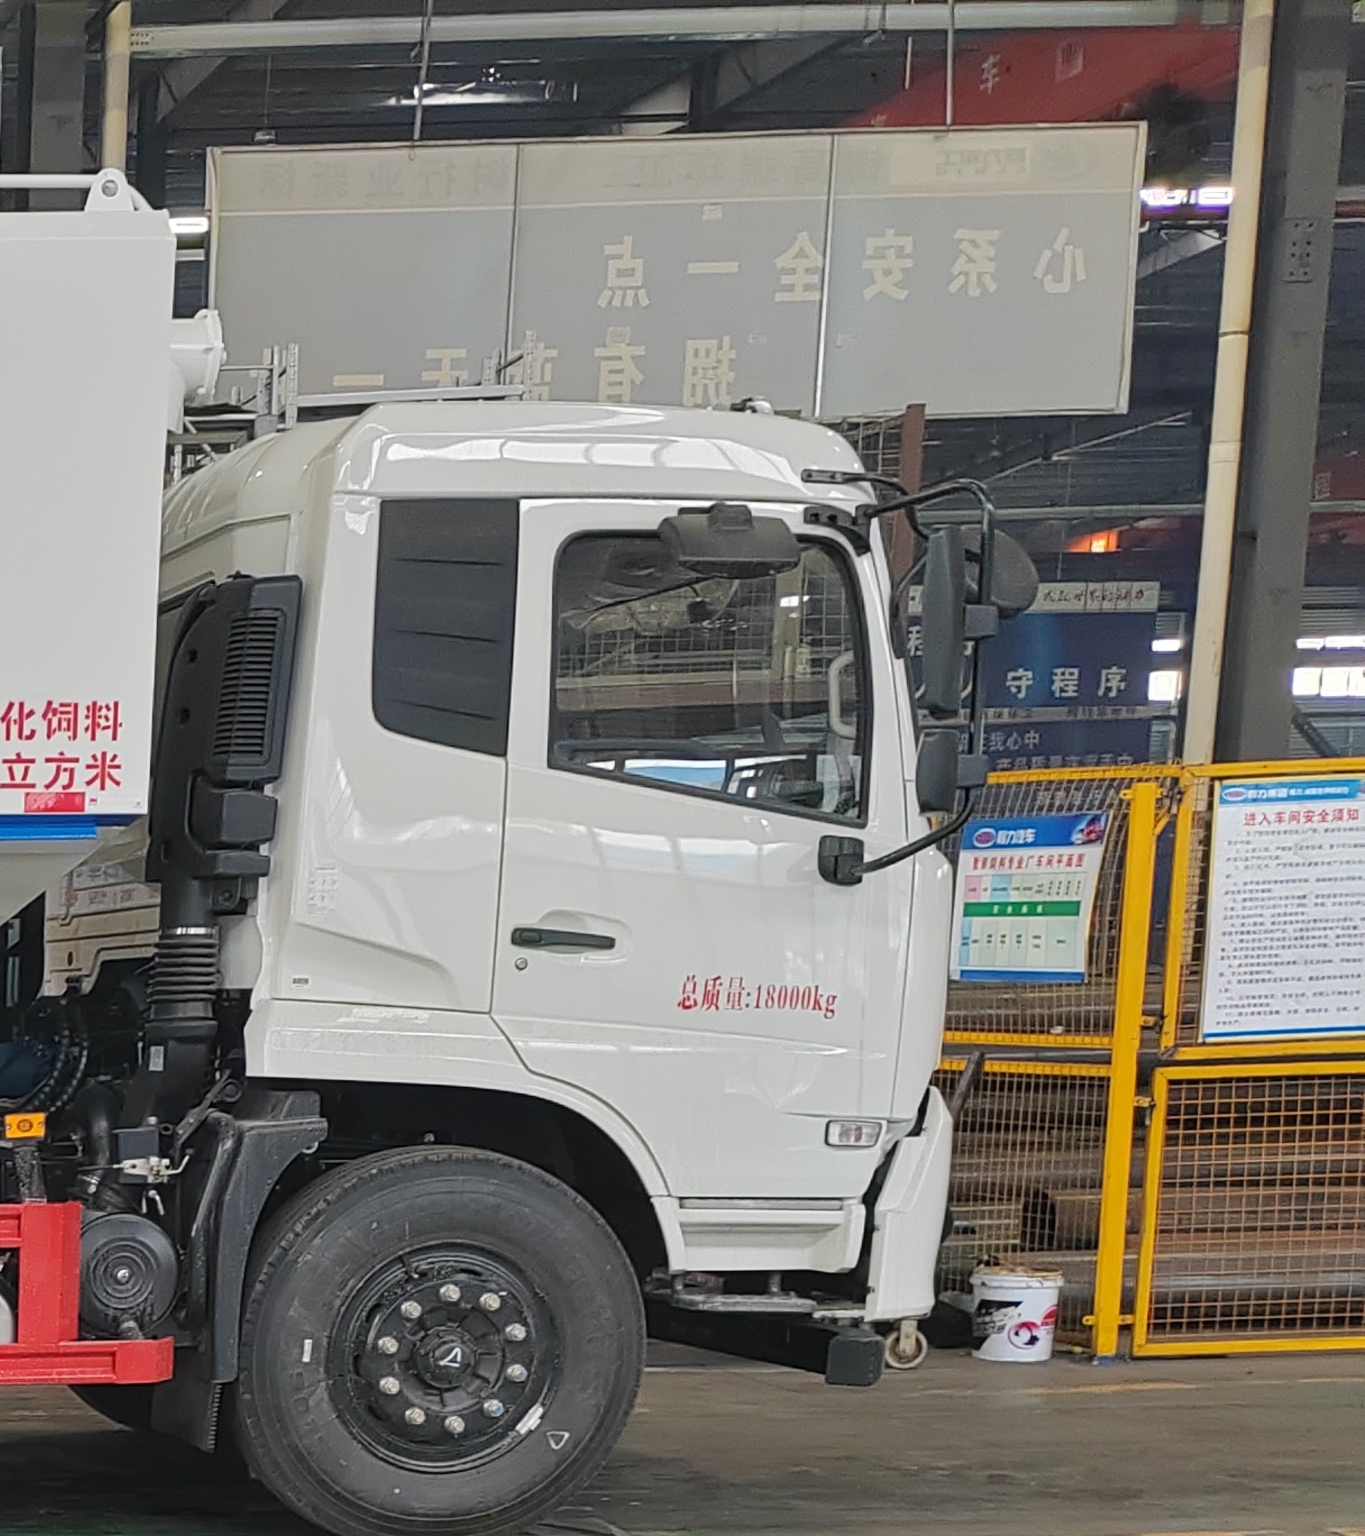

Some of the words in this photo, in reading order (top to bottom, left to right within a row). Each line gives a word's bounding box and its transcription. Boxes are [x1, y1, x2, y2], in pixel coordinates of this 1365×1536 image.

[1244, 808, 1359, 827] 进入车间安全须知
